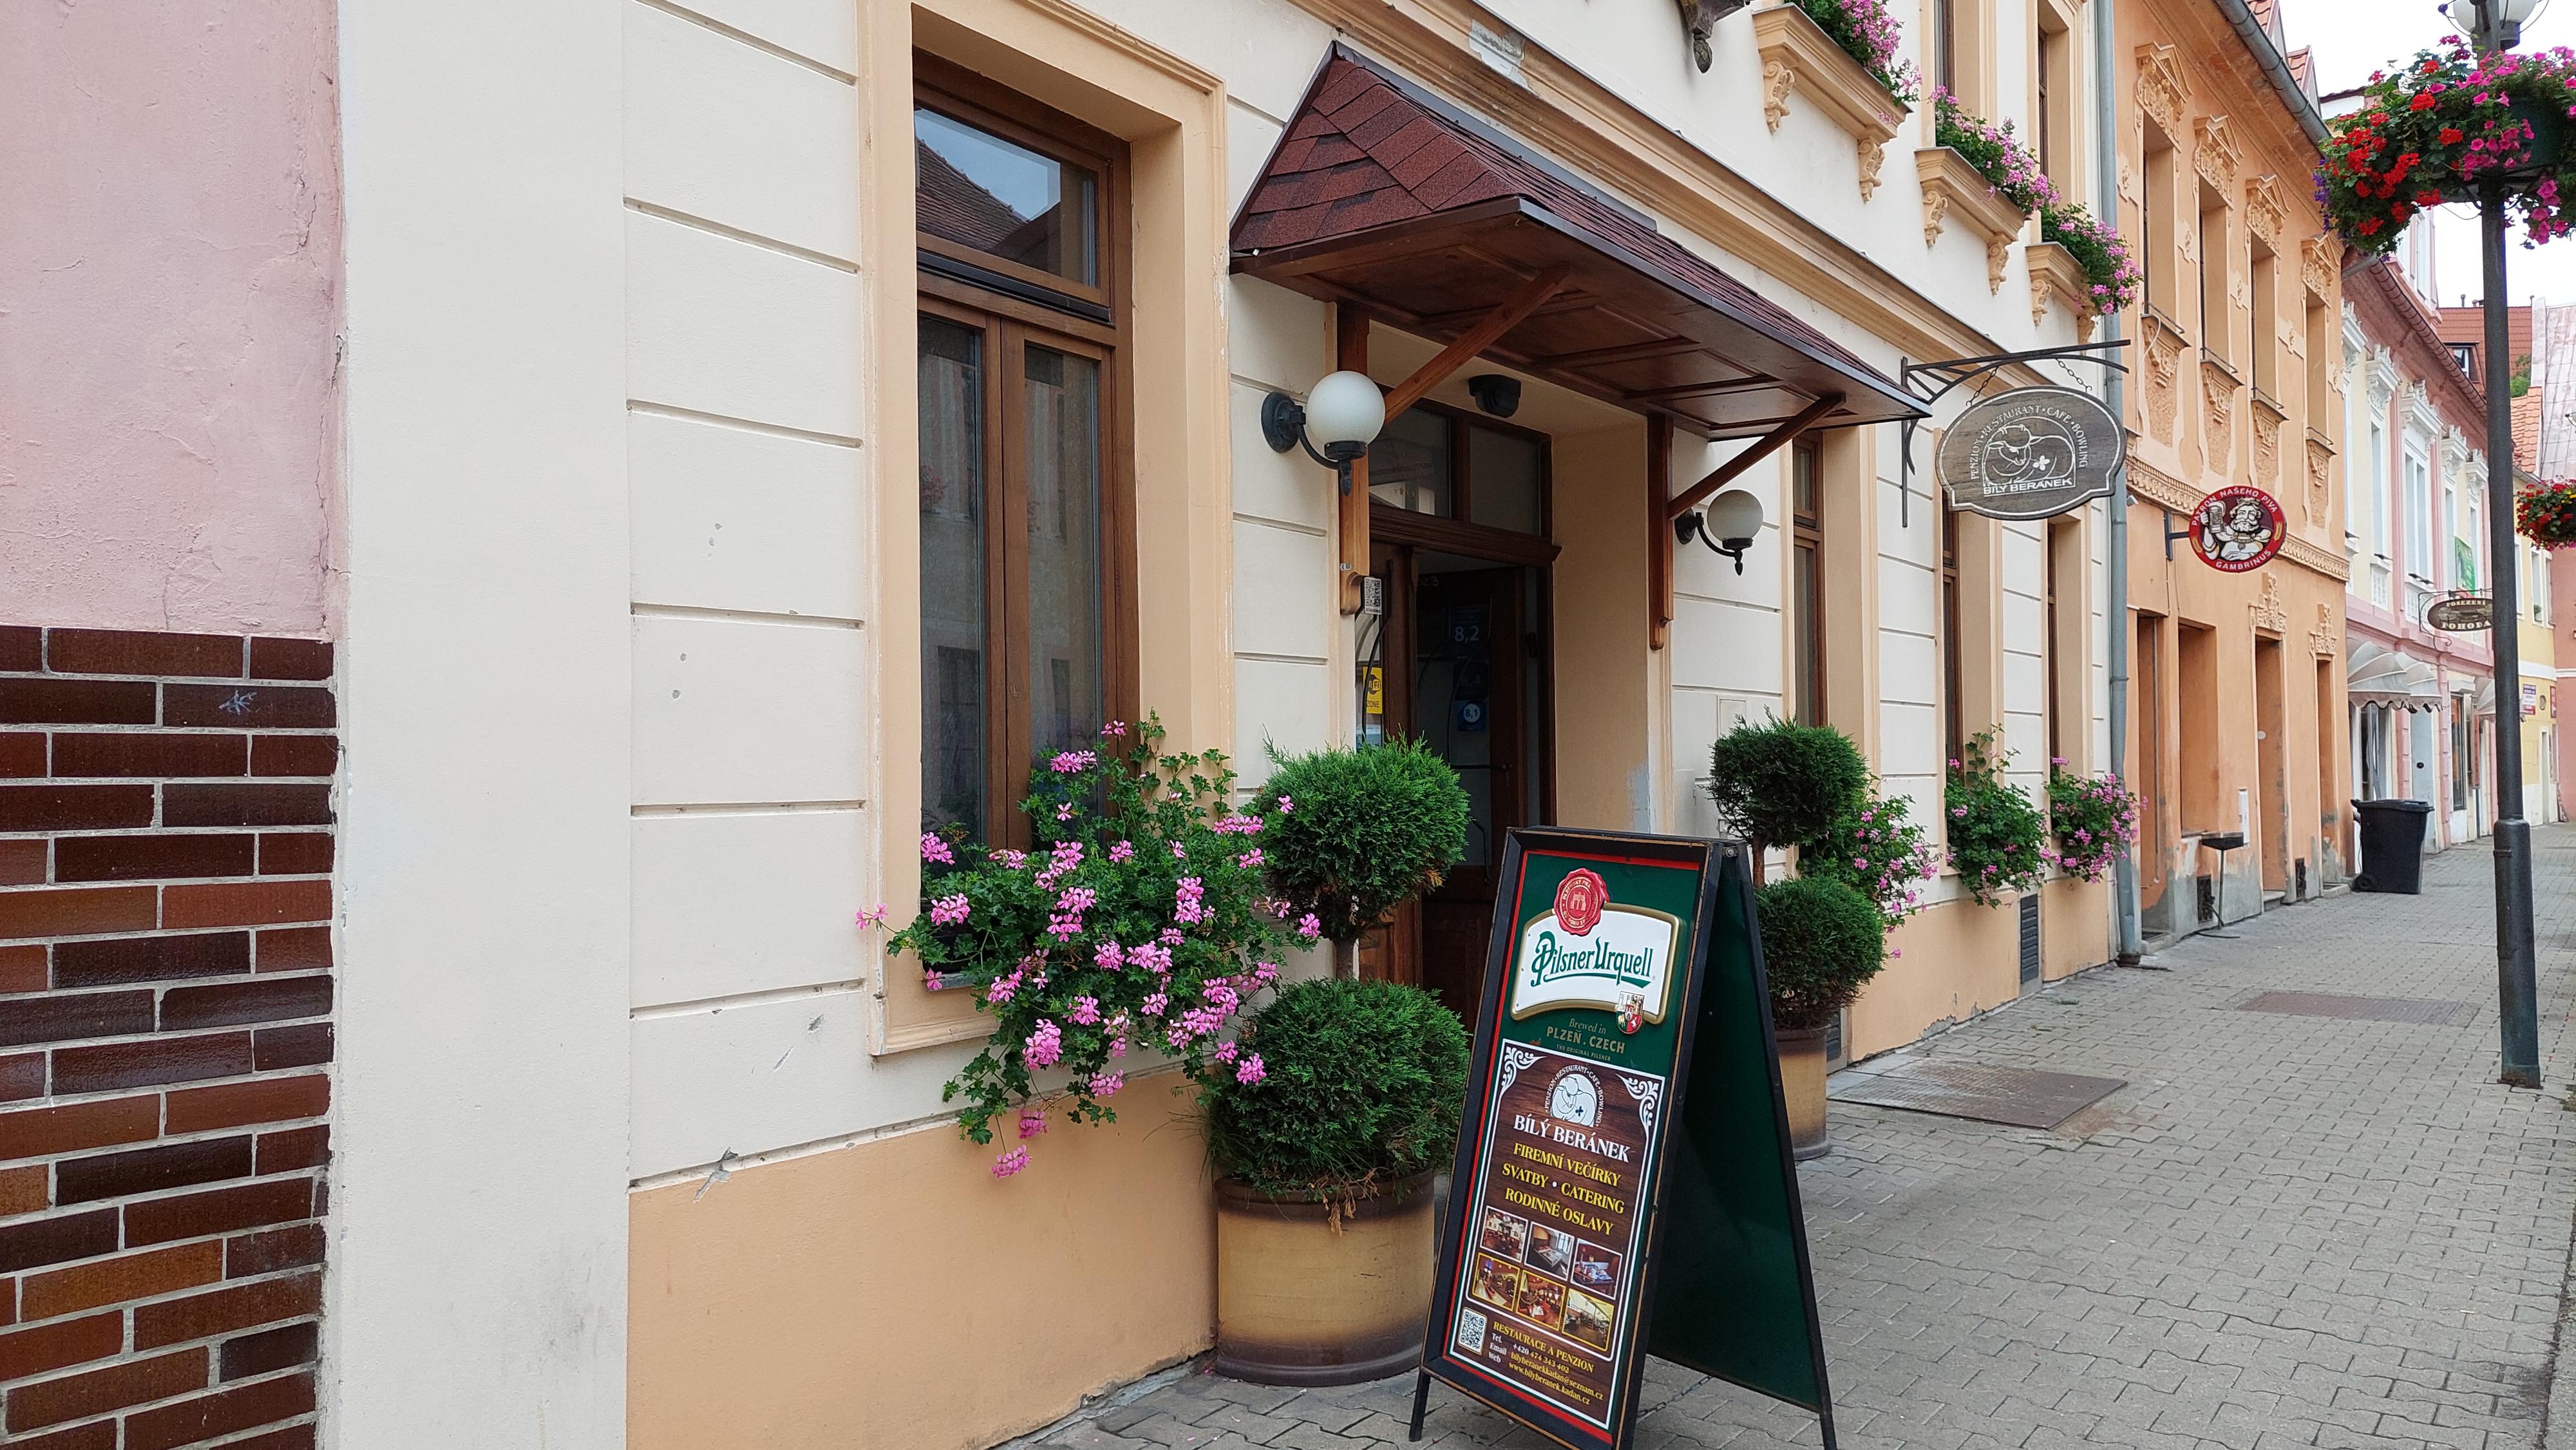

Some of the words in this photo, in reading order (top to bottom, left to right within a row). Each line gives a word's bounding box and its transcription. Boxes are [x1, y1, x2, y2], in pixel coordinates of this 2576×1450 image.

[1970, 438, 1982, 480] PENZION
[1982, 405, 2041, 437] RESTAURANT
[2070, 422, 2088, 469] BOWLING
[2192, 496, 2217, 526] PATRON
[2220, 486, 2259, 497] NAŠEHO
[2261, 495, 2278, 513] PIVA
[2215, 549, 2272, 570] GAMBRINUS
[1454, 625, 1479, 643] 8,2
[2441, 620, 2492, 630] POHODA
[1366, 700, 1379, 708] ZONE
[1530, 930, 1595, 987] Pilsner
[1593, 936, 1654, 986] Urquell
[1546, 1026, 1582, 1044] PLZEŇ
[1589, 1035, 1625, 1054] CZECH
[1569, 1018, 1597, 1033] Brewed
[1598, 1024, 1607, 1035] in
[1566, 1046, 1590, 1057] ORIGINAL
[1591, 1051, 1611, 1062] PILSNER
[1544, 1078, 1557, 1109] PENZION
[1556, 1064, 1587, 1079] RESTAURANT
[1596, 1088, 1604, 1124] BOWLING
[1513, 1113, 1551, 1138] BÍLÝ
[1553, 1131, 1631, 1163] BERÁNEK
[1513, 1142, 1565, 1169] FIREMNÍ
[1567, 1158, 1622, 1187] VEČÍRKY
[1502, 1163, 1549, 1189] SVATBY
[1560, 1182, 1625, 1214] CATERING
[1505, 1187, 1561, 1218] RODINNÉ
[1562, 1208, 1614, 1236] OSLAVY
[1488, 1350, 1501, 1364] Web
[1493, 1321, 1546, 1351] RESTAURACE
[1548, 1345, 1555, 1356] A
[1556, 1349, 1594, 1373] PENZION
[1513, 1343, 1530, 1355] +420
[1530, 1350, 1543, 1361] 474
[1543, 1356, 1557, 1368] 343
[1557, 1363, 1570, 1374] 402
[1489, 1342, 1508, 1355] Email
[1510, 1351, 1604, 1400] bilyberanekkadan@seznam.cz
